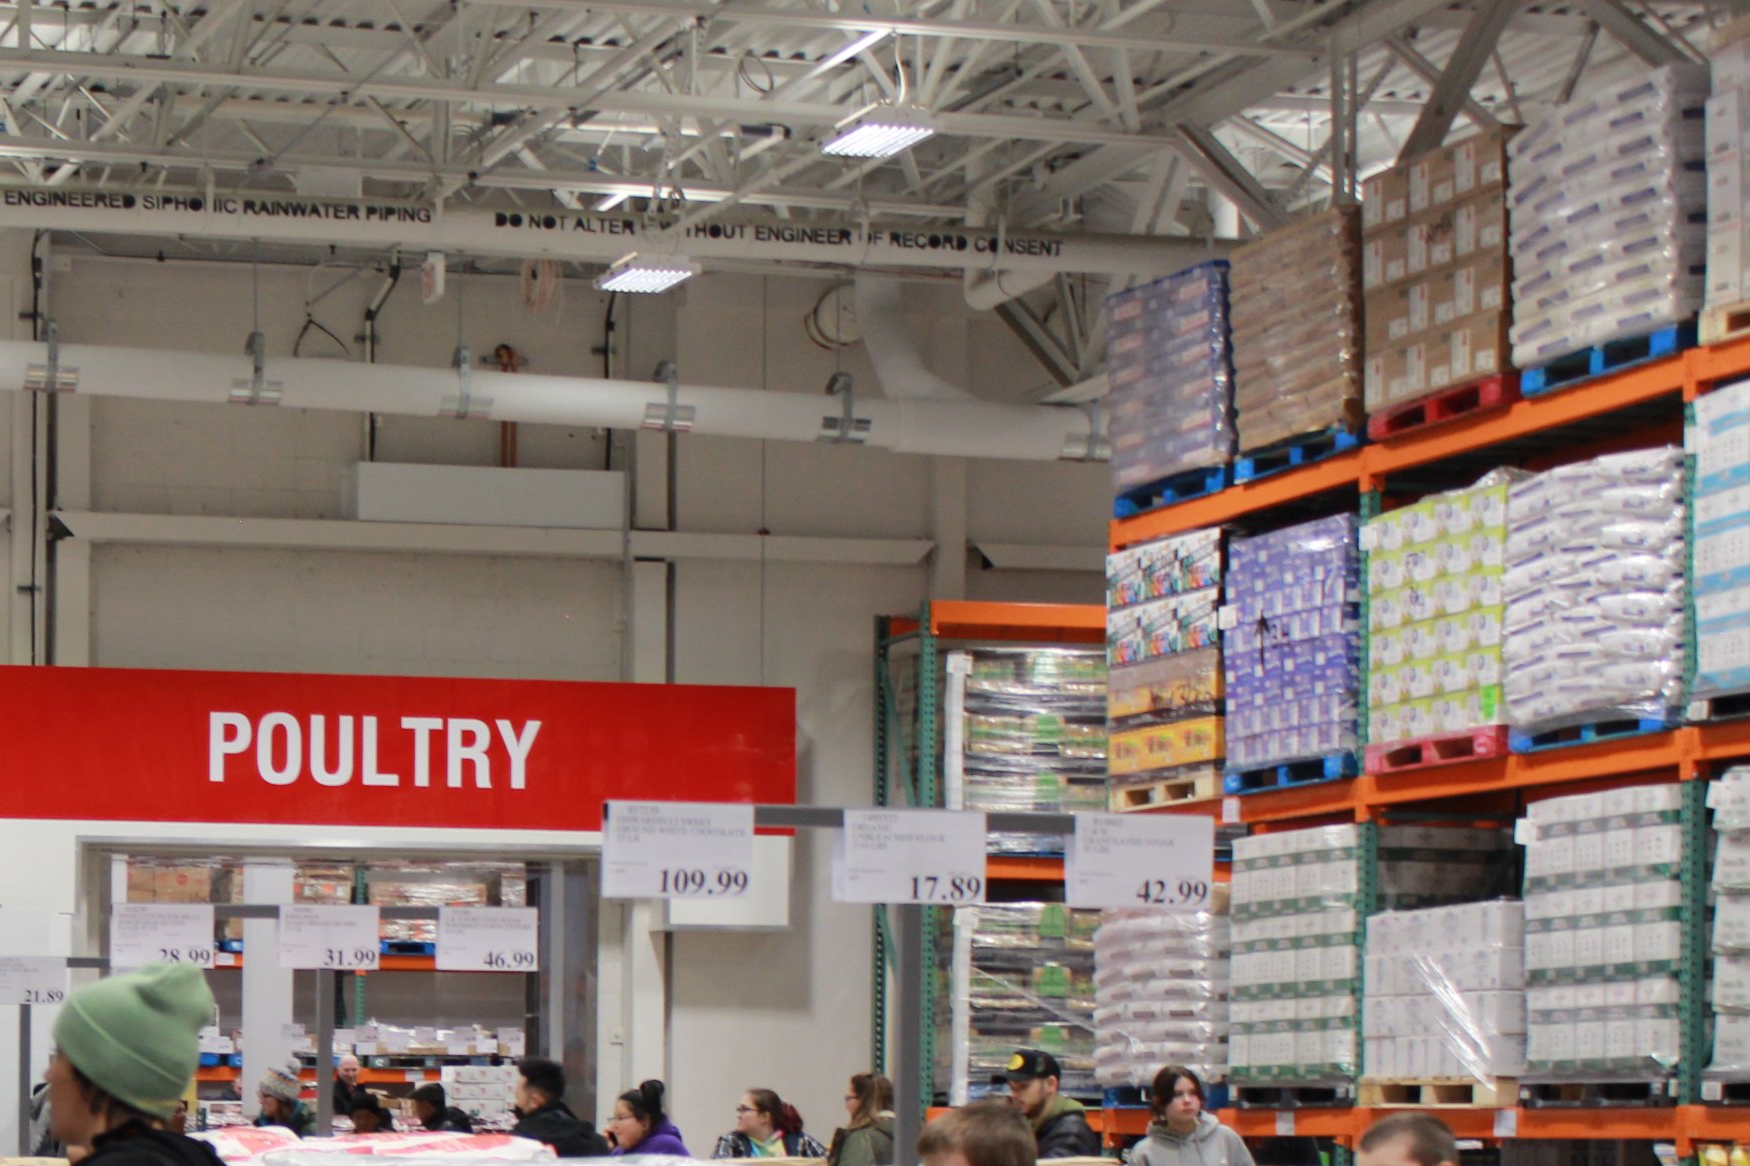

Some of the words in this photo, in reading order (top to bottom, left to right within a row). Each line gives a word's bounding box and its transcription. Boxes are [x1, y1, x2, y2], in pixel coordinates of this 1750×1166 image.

[3, 190, 136, 209] ENGINEERED
[243, 198, 360, 221] RAINWATER
[365, 205, 432, 224] PIPING
[495, 212, 523, 228] DO
[529, 213, 568, 231] NOT
[573, 216, 636, 236] ALTER
[658, 220, 747, 241] WHOUT
[754, 225, 851, 246] ENGINEER
[889, 231, 968, 252] RECORD
[208, 711, 542, 790] POULTRY
[659, 868, 748, 896] 109.99
[910, 875, 981, 901] 17.89
[1136, 879, 1208, 905] 42.99
[159, 947, 211, 966] 2899
[323, 947, 376, 967] 31.99
[482, 950, 535, 969] 46.99
[23, 988, 66, 1005] 21.89
